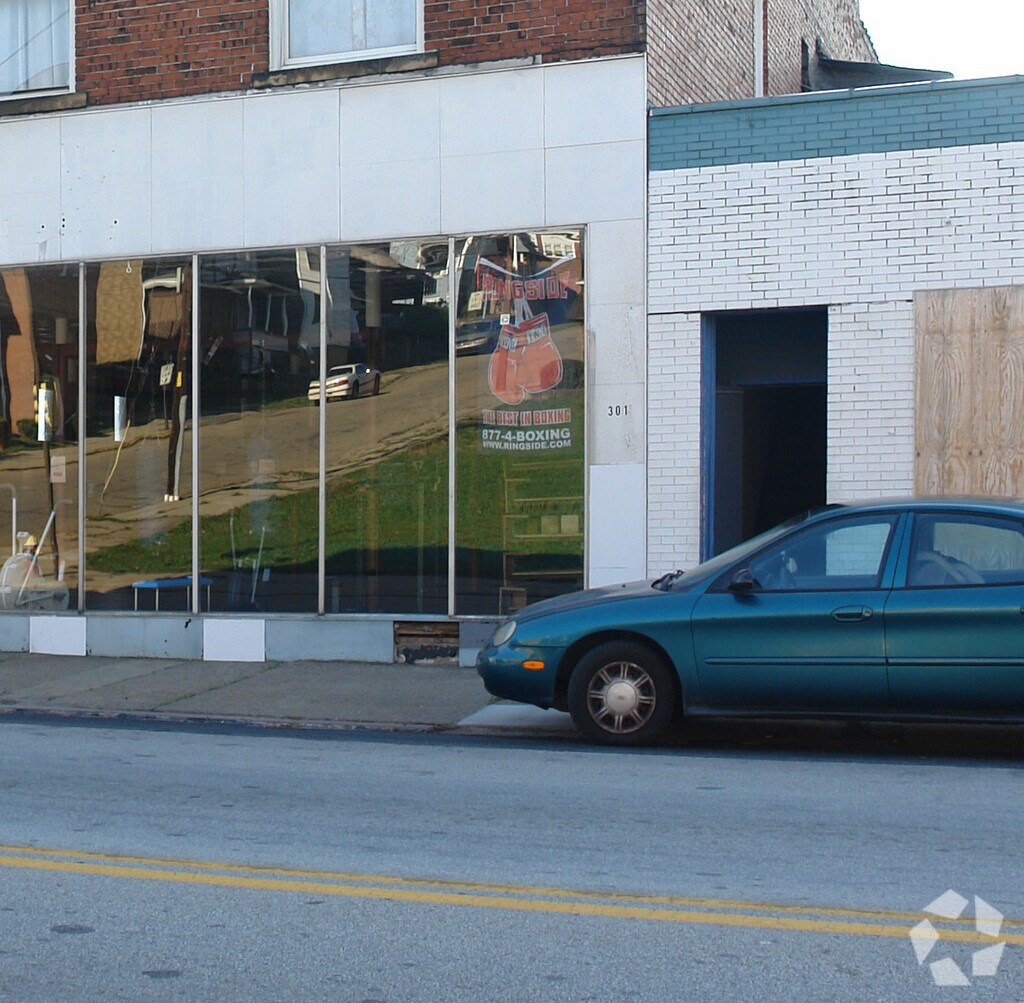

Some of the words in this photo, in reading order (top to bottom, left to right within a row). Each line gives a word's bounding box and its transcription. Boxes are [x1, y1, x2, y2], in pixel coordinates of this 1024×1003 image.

[482, 271, 570, 301] RINGSIDE
[482, 409, 496, 426] THE
[496, 410, 519, 427] BEST
[519, 410, 532, 427] IN
[533, 407, 572, 426] BOXING
[607, 405, 628, 417] 301
[482, 427, 571, 442] 877-4-BOXING
[482, 439, 572, 451] WWW.RINGSIDE.COM
